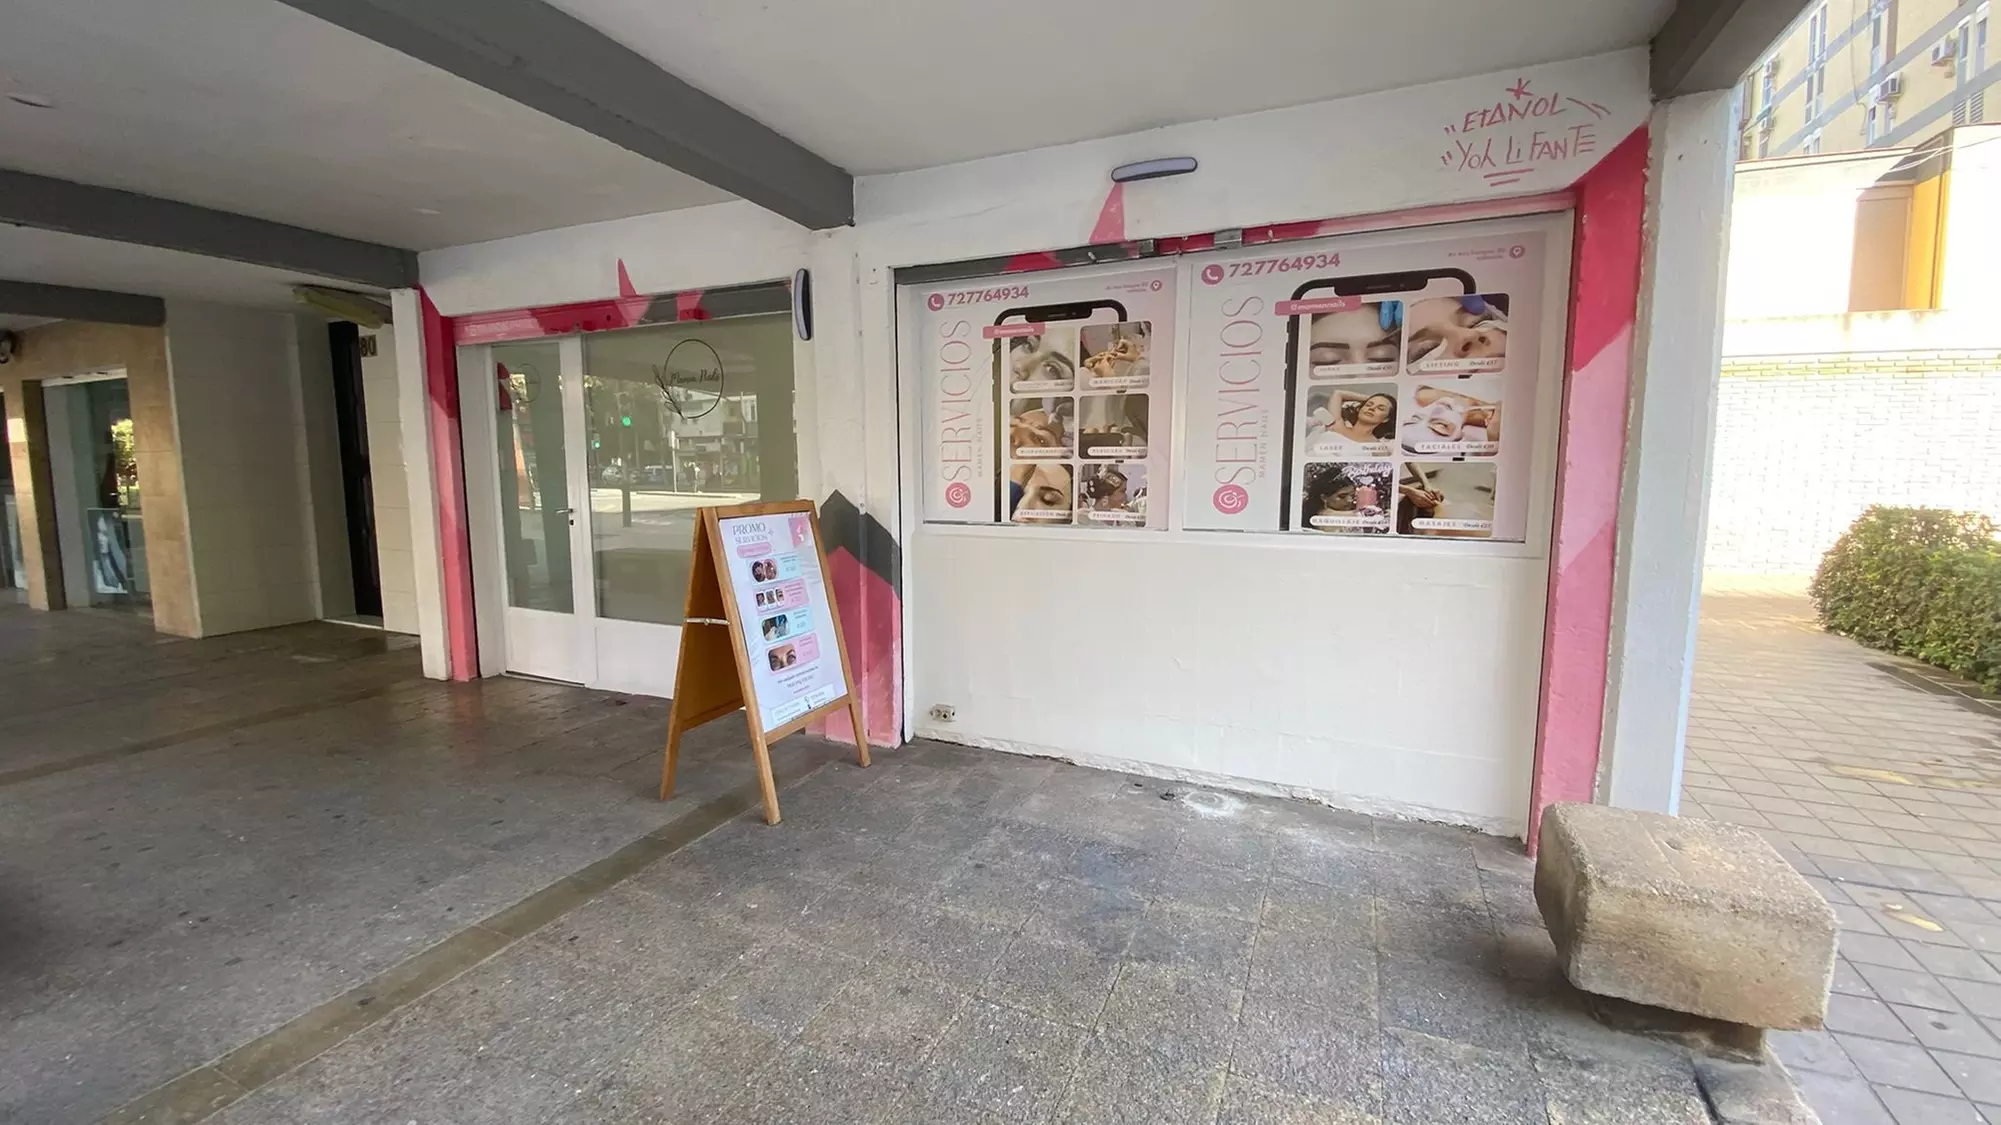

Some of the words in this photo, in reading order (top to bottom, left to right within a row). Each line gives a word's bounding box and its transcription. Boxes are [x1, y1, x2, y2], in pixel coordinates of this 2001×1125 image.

[1229, 252, 1342, 279] 727764934
[947, 286, 1030, 306] 727764934
[939, 320, 972, 482] SERVICIOS
[1214, 295, 1265, 486] SERVICIOS
[732, 522, 767, 536] PROMO
